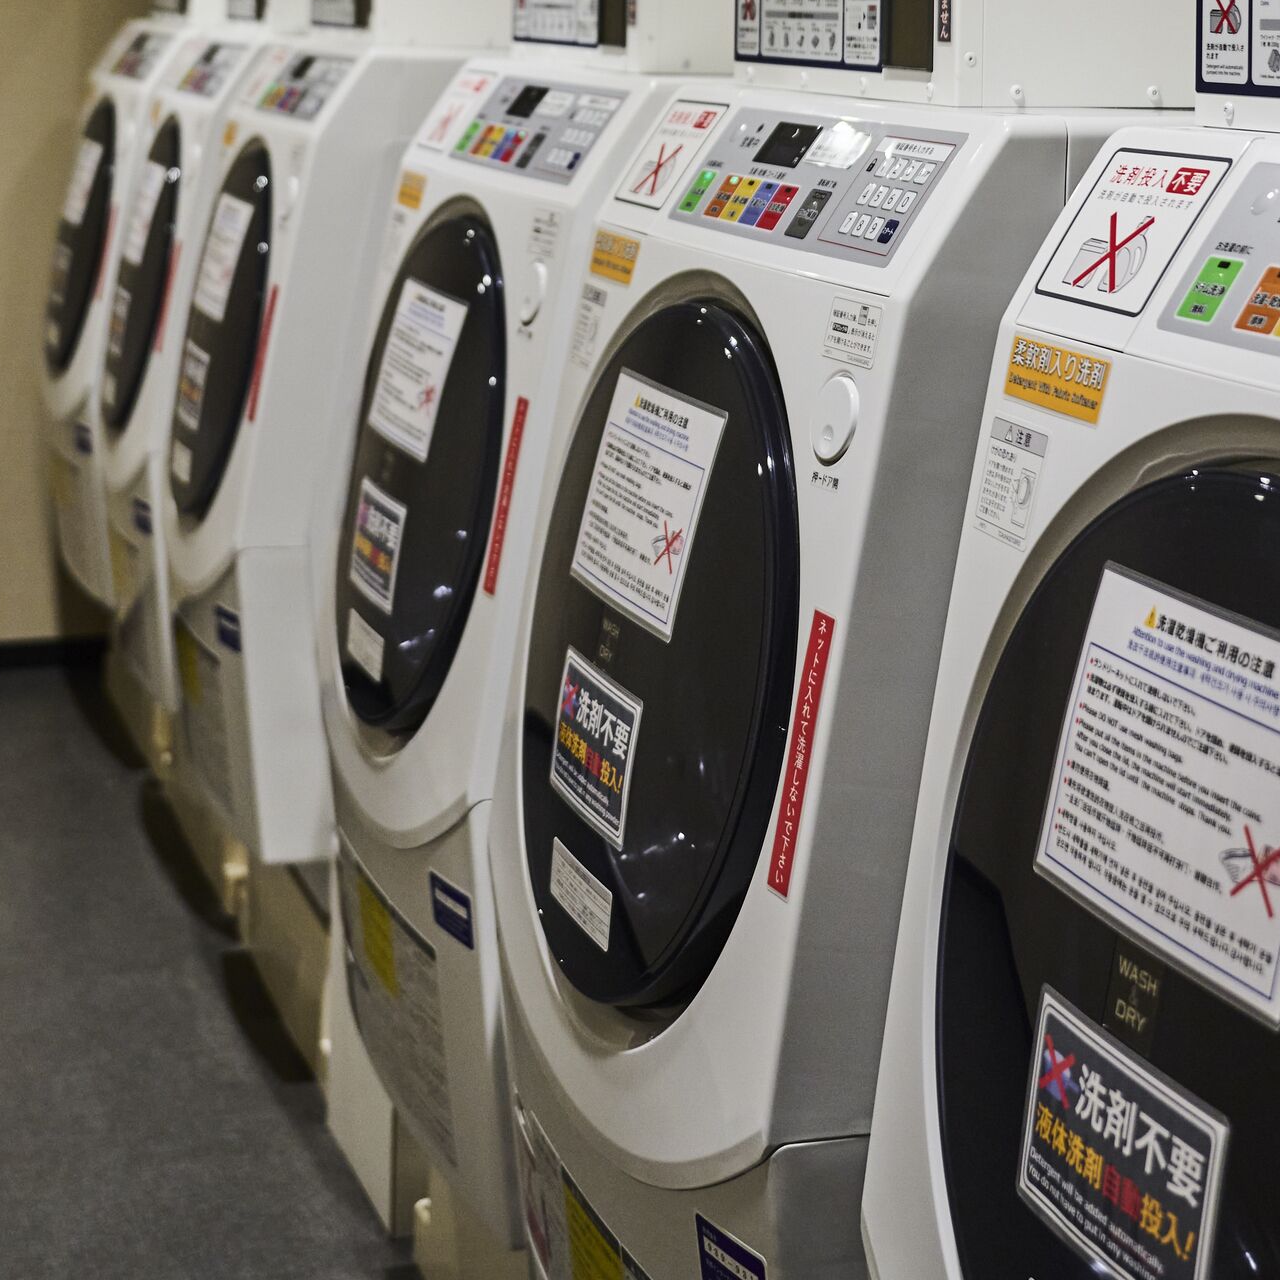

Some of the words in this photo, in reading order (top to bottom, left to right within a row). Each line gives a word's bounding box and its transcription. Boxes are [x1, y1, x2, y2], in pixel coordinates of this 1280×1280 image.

[1097, 189, 1194, 210] 洗剤が自動で投入されます
[1110, 164, 1169, 189] 洗剤投入
[1169, 169, 1209, 194] 不要
[1008, 372, 1038, 392] Detergent
[1011, 338, 1107, 392] 柔軟剤入り洗剤
[1015, 428, 1032, 449] 注意
[1132, 625, 1156, 643] Attention
[1163, 641, 1174, 652] use
[1174, 645, 1185, 657] the
[1156, 613, 1276, 679] 洗濯乾燥機ご利用の注意
[575, 687, 631, 761] 洗剤不要
[774, 619, 828, 884] ネットに入れて洗濯しないで下さい
[1143, 736, 1167, 756] washing
[1152, 758, 1177, 778] machine
[1119, 954, 1158, 997] WASH
[1114, 998, 1147, 1033] DRY
[1074, 1063, 1206, 1209] 洗剤不要
[1034, 1101, 1196, 1261] 液体洗剤自動投入!
[1028, 1163, 1041, 1181] You
[1040, 1176, 1049, 1190] do
[1050, 1185, 1060, 1199] not
[1060, 1193, 1076, 1215] have
[1076, 1210, 1084, 1224] to
[1084, 1218, 1099, 1238] put
[1106, 1239, 1122, 1260] any
[1029, 1145, 1062, 1183] Detergent
[1061, 1180, 1074, 1197] will
[1074, 1190, 1083, 1205] be
[1084, 1201, 1108, 1226] added
[1108, 1221, 1164, 1275] automatically.
